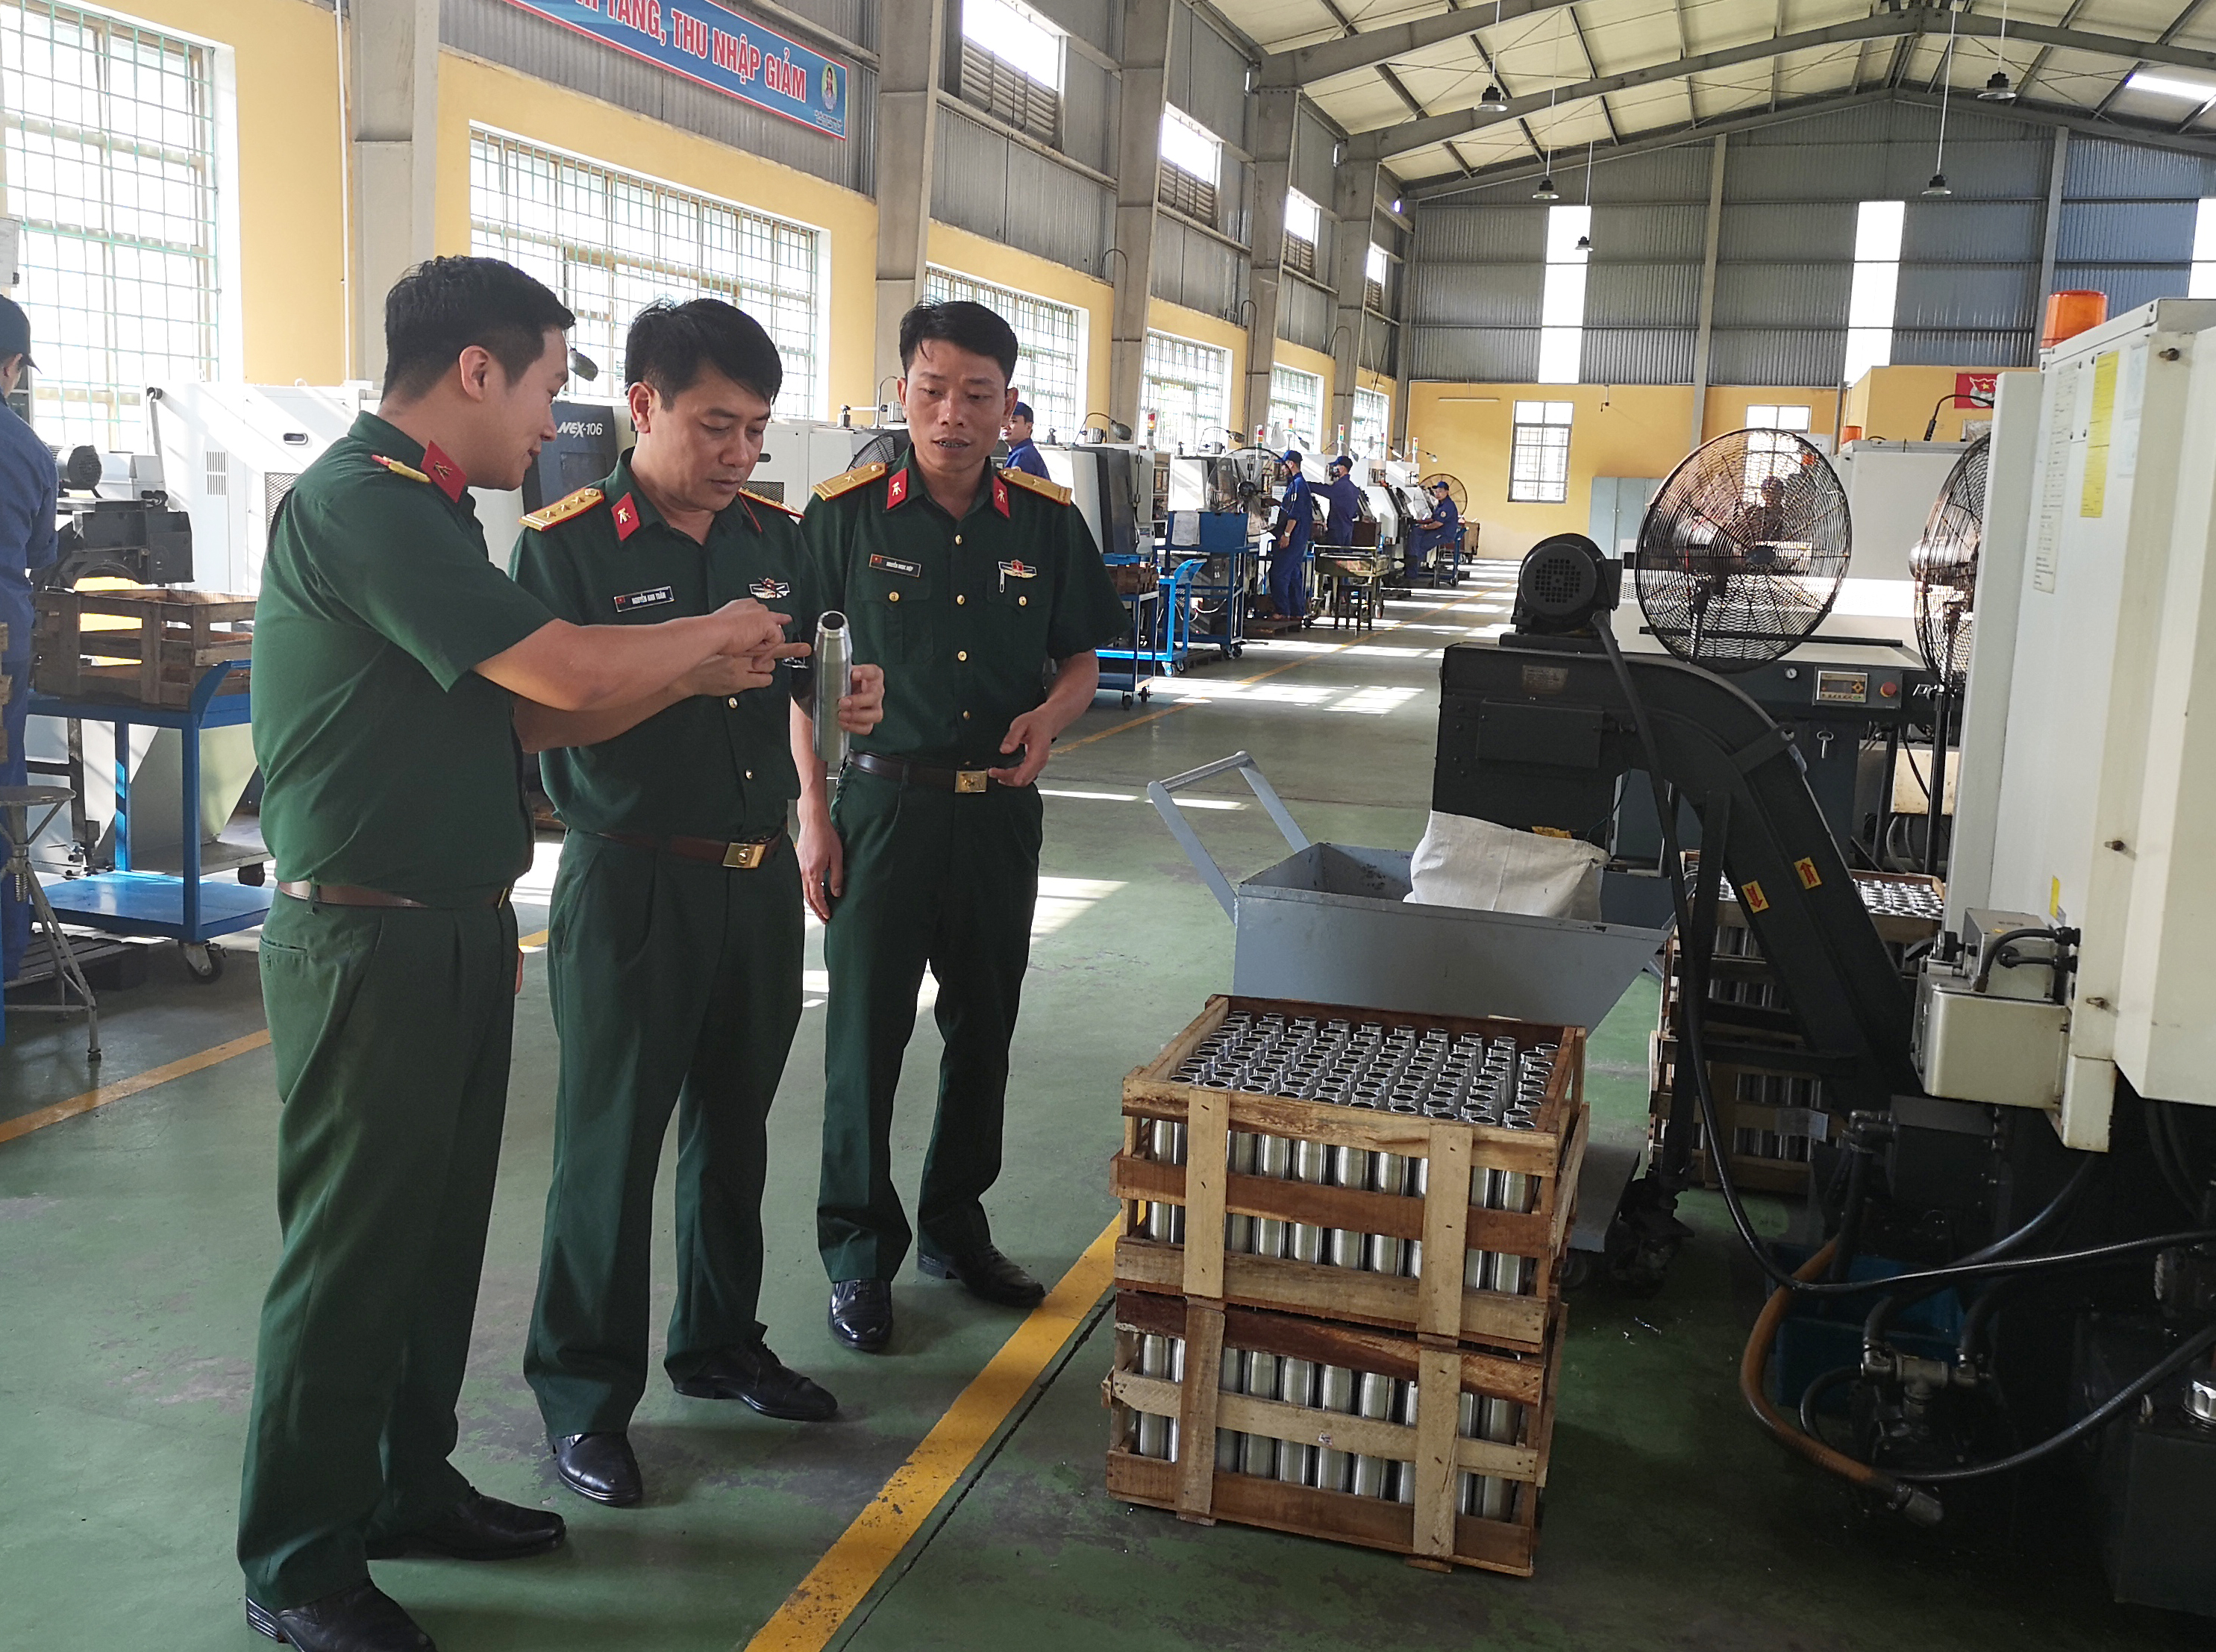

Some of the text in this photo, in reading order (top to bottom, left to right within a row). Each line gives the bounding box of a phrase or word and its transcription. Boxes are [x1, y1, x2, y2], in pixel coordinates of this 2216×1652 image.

[671, 8, 708, 60] THU
[712, 27, 761, 85] NHẬP
[764, 46, 807, 103] GIẢM
[557, 422, 603, 438] NEX-106
